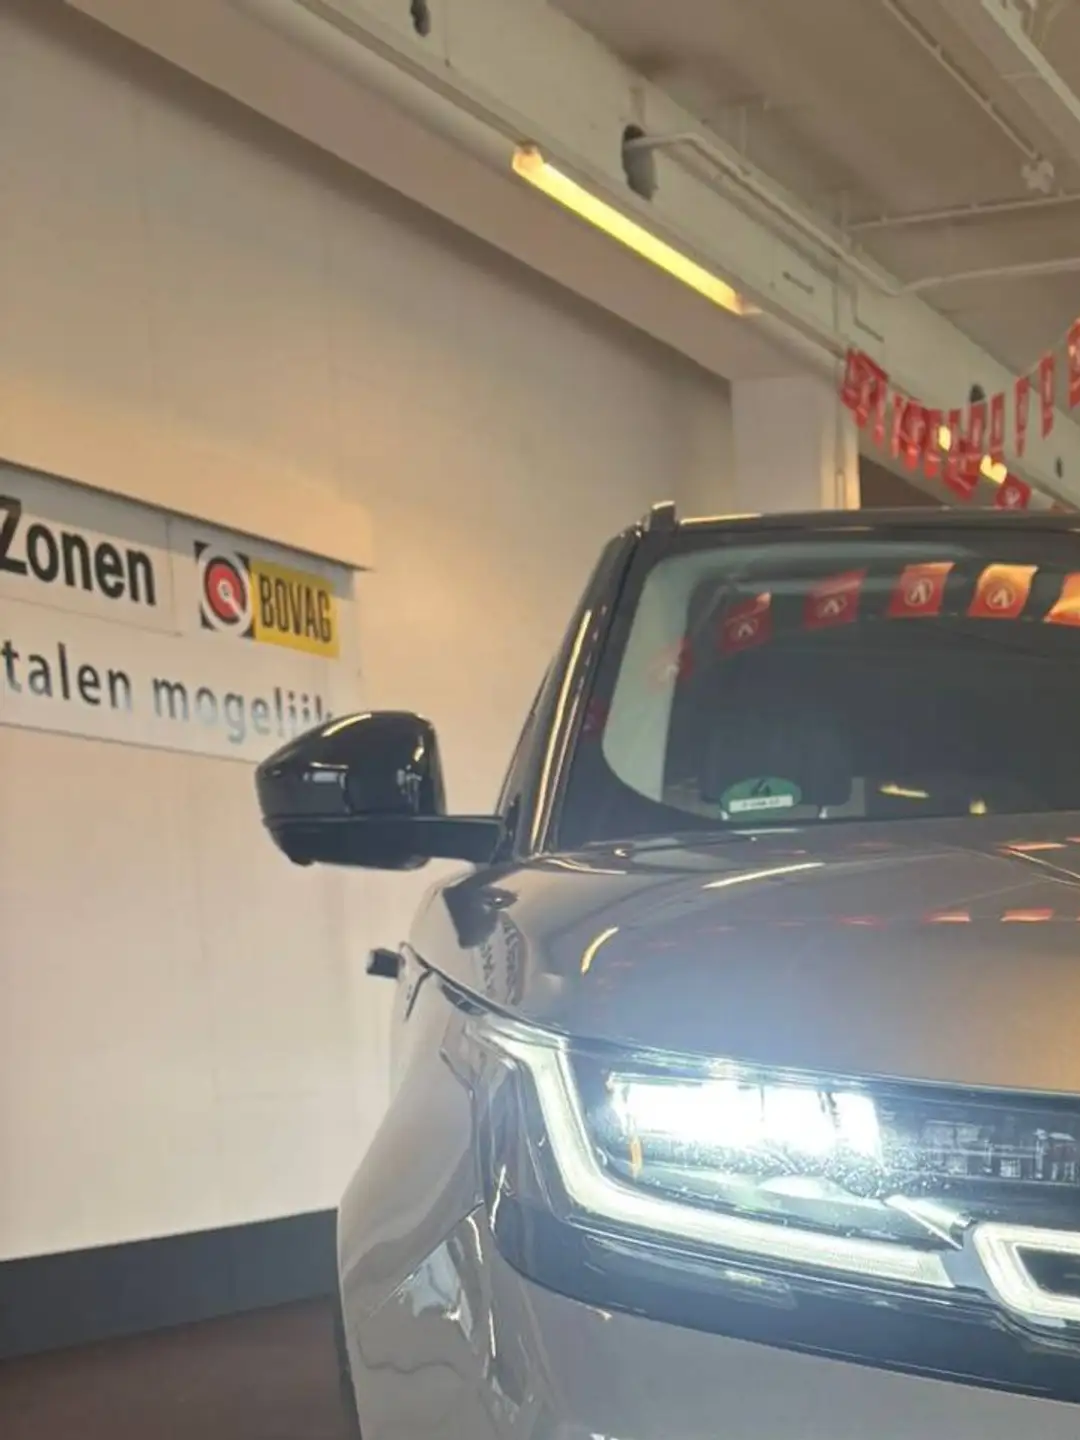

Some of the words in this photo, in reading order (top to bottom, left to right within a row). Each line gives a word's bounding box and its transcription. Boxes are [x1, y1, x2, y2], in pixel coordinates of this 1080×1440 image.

[0, 495, 156, 607] Zonen
[259, 574, 331, 643] BOVAG
[0, 639, 132, 711] talen
